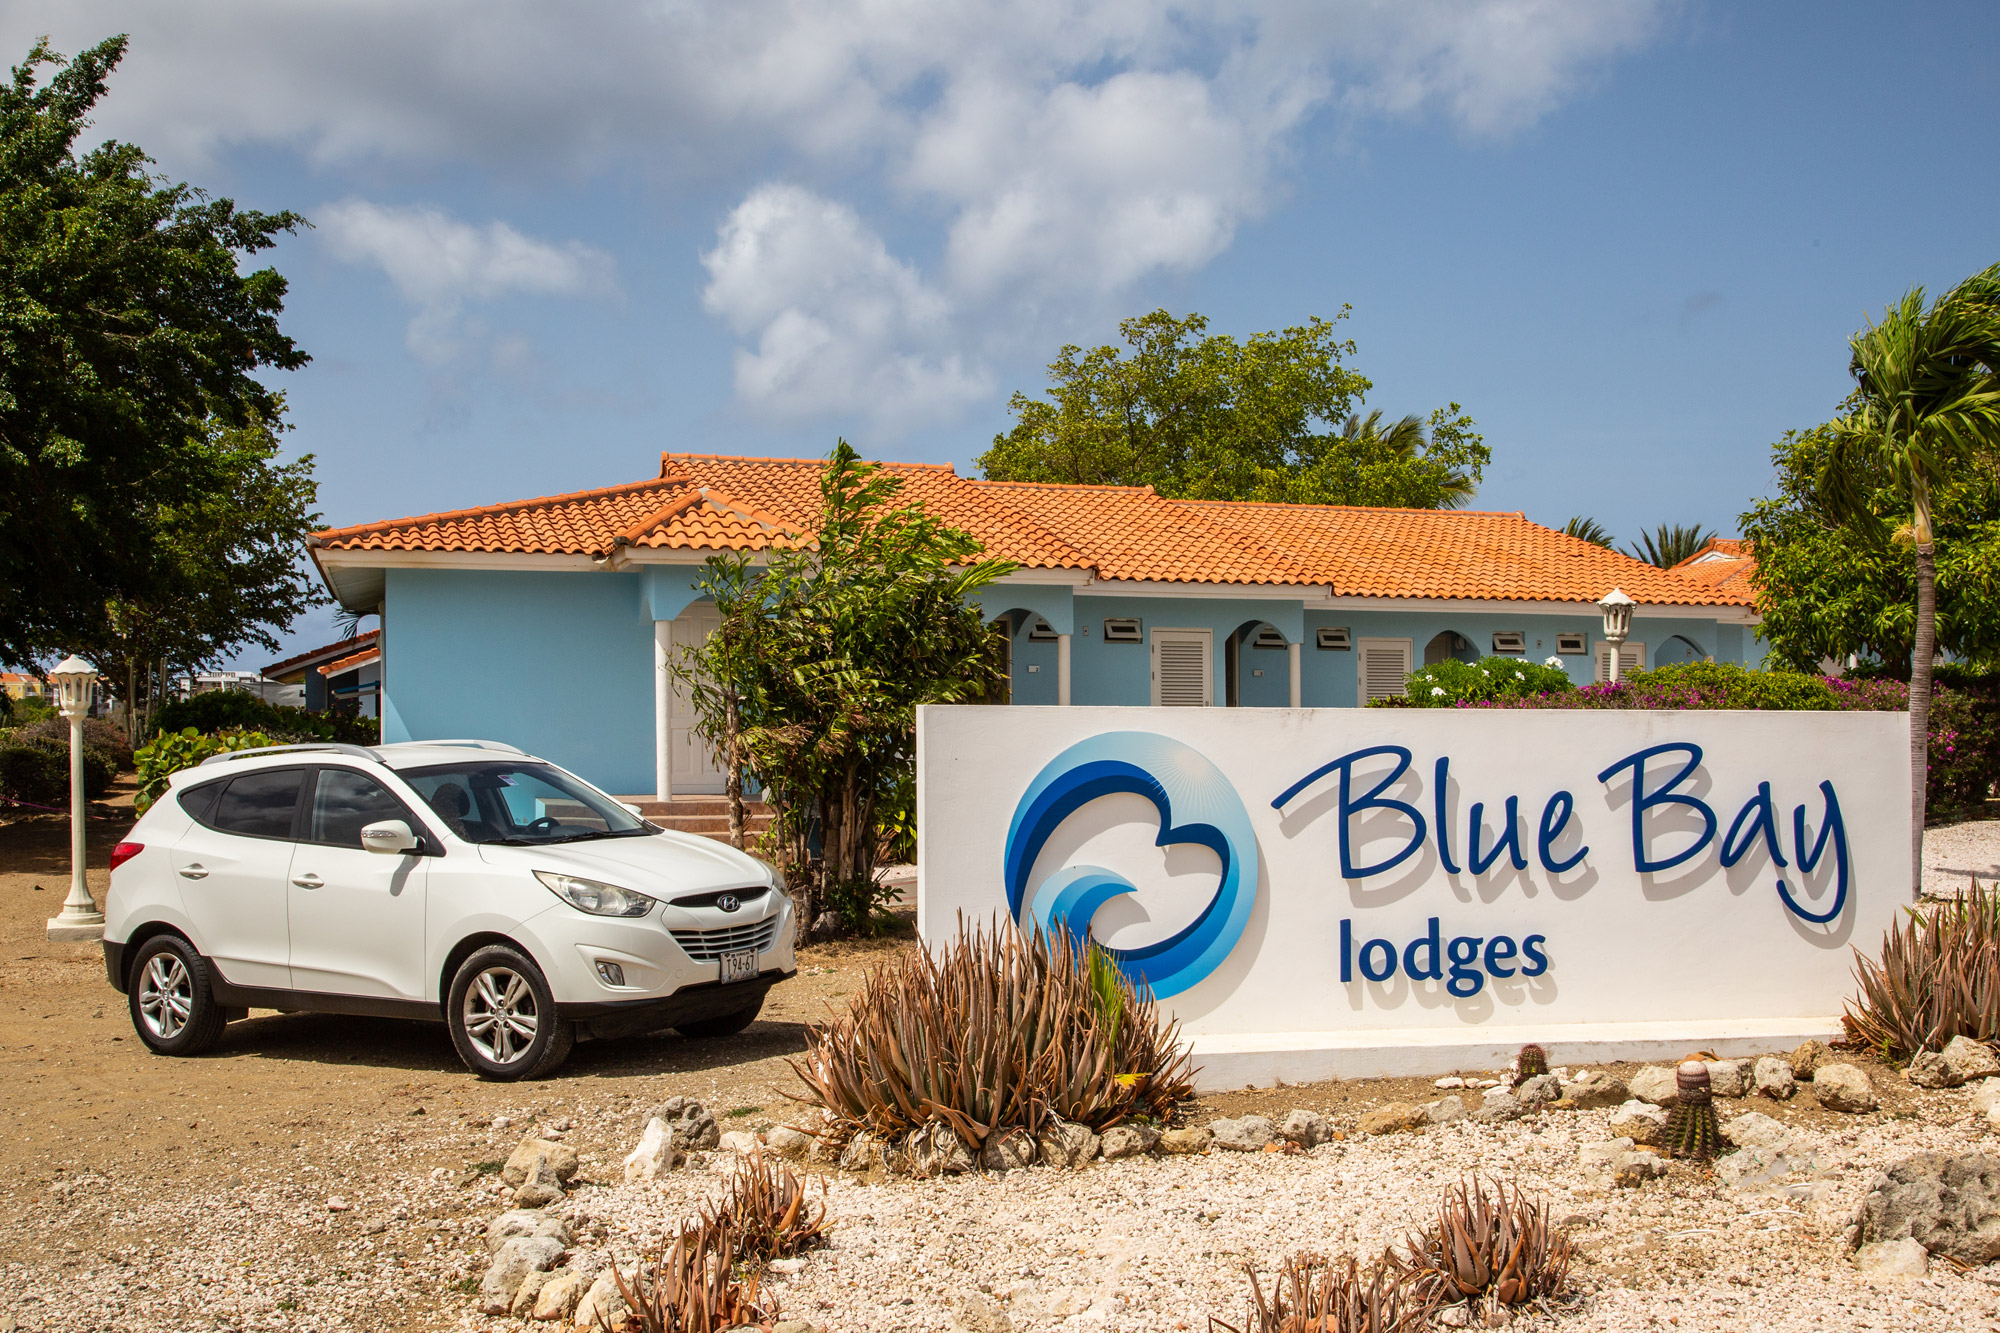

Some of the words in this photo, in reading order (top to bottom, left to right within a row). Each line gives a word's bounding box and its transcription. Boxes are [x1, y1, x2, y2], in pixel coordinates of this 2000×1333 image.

[1271, 745, 1589, 879] Blue
[1597, 742, 1849, 923] Bay
[1340, 917, 1548, 998] lodges
